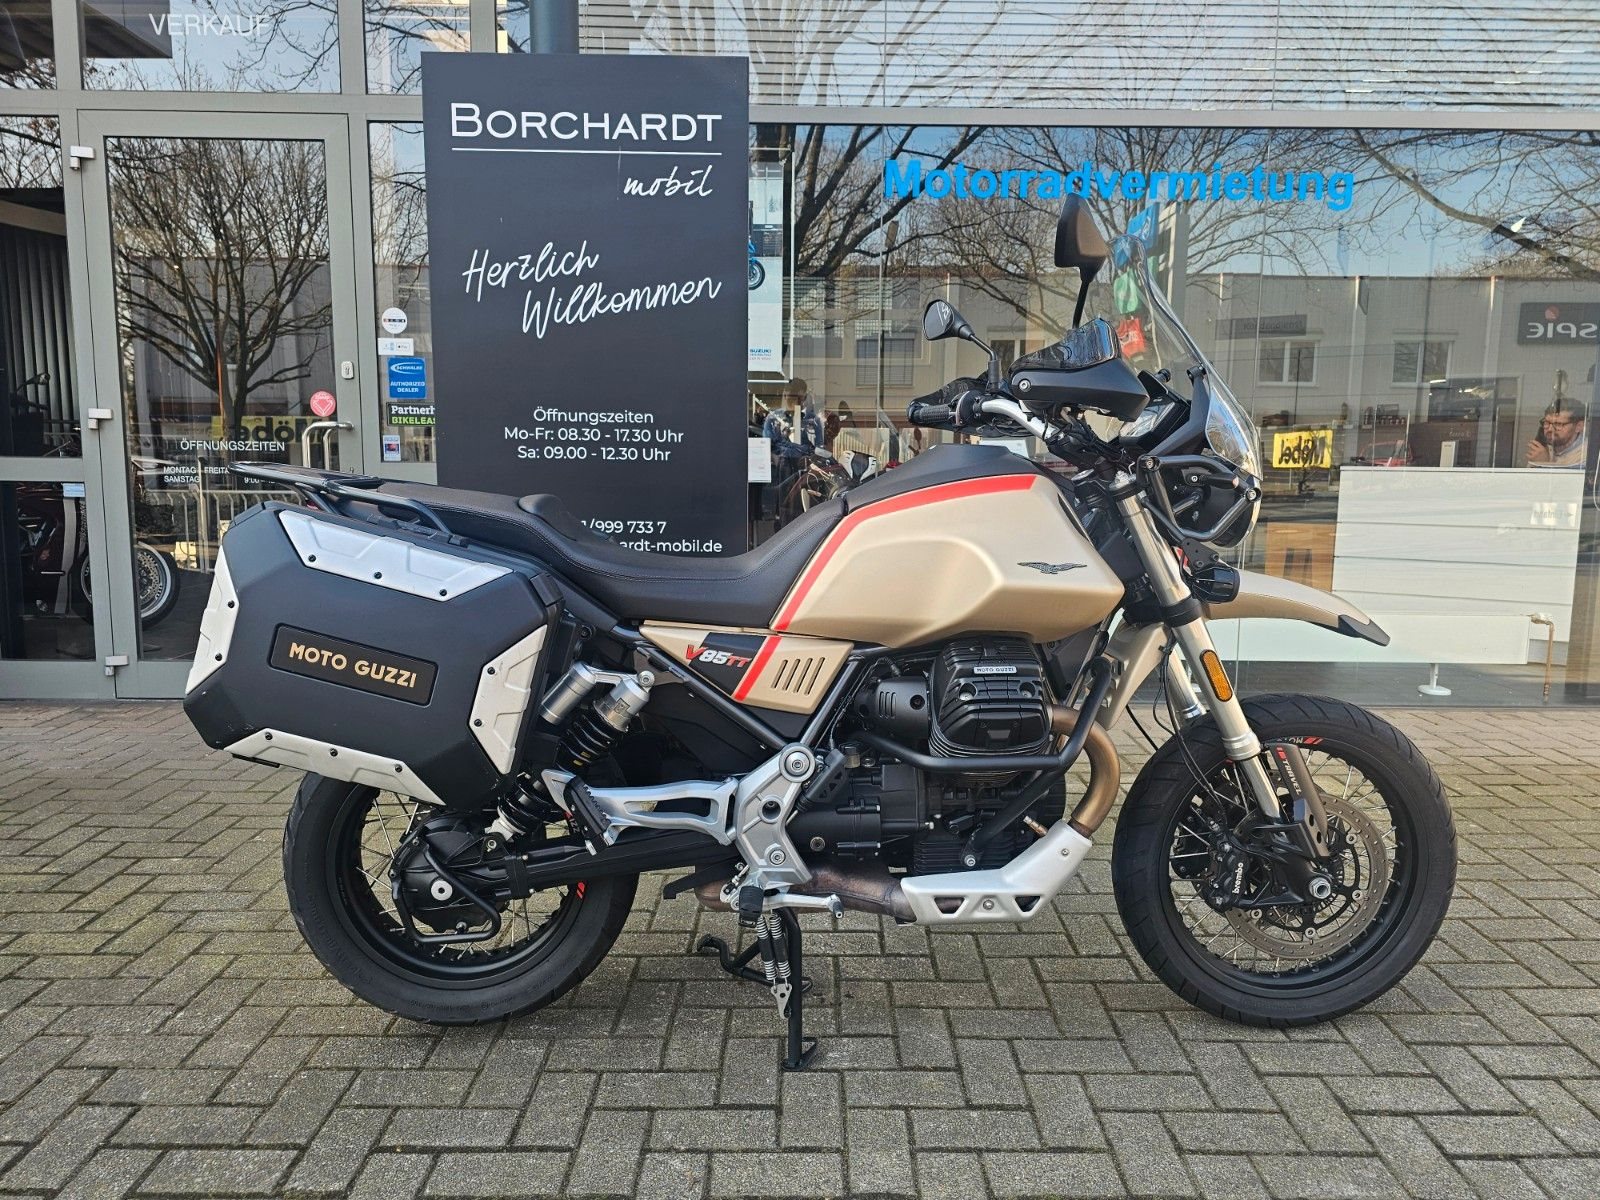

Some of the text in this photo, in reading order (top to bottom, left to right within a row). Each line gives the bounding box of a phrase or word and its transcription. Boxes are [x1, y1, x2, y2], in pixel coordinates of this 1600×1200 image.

[148, 13, 270, 36] VERKAUF
[450, 102, 723, 142] BORCHARDT
[623, 164, 713, 197] mobil
[884, 158, 1354, 211] Motorradvermietung
[462, 240, 599, 302] Herzlich
[522, 277, 722, 339] Willkommen
[533, 406, 654, 425] Öffnungszeiten
[180, 438, 285, 451] ÖFFNUNGSZEITEN
[504, 427, 554, 441] Mo-Fr:
[558, 428, 601, 442] 08.30
[614, 429, 652, 443] 17.30
[656, 430, 684, 443] Uhr
[518, 446, 540, 460] Sa:
[544, 446, 587, 460] 09.00
[601, 447, 638, 461] 12.30
[642, 448, 671, 461] Uhr
[627, 521, 653, 534] 733
[657, 521, 667, 534] 7
[289, 642, 417, 688] MOTO GUZZI
[1282, 759, 1302, 796] TRAVEL
[1232, 862, 1244, 894] brembo
